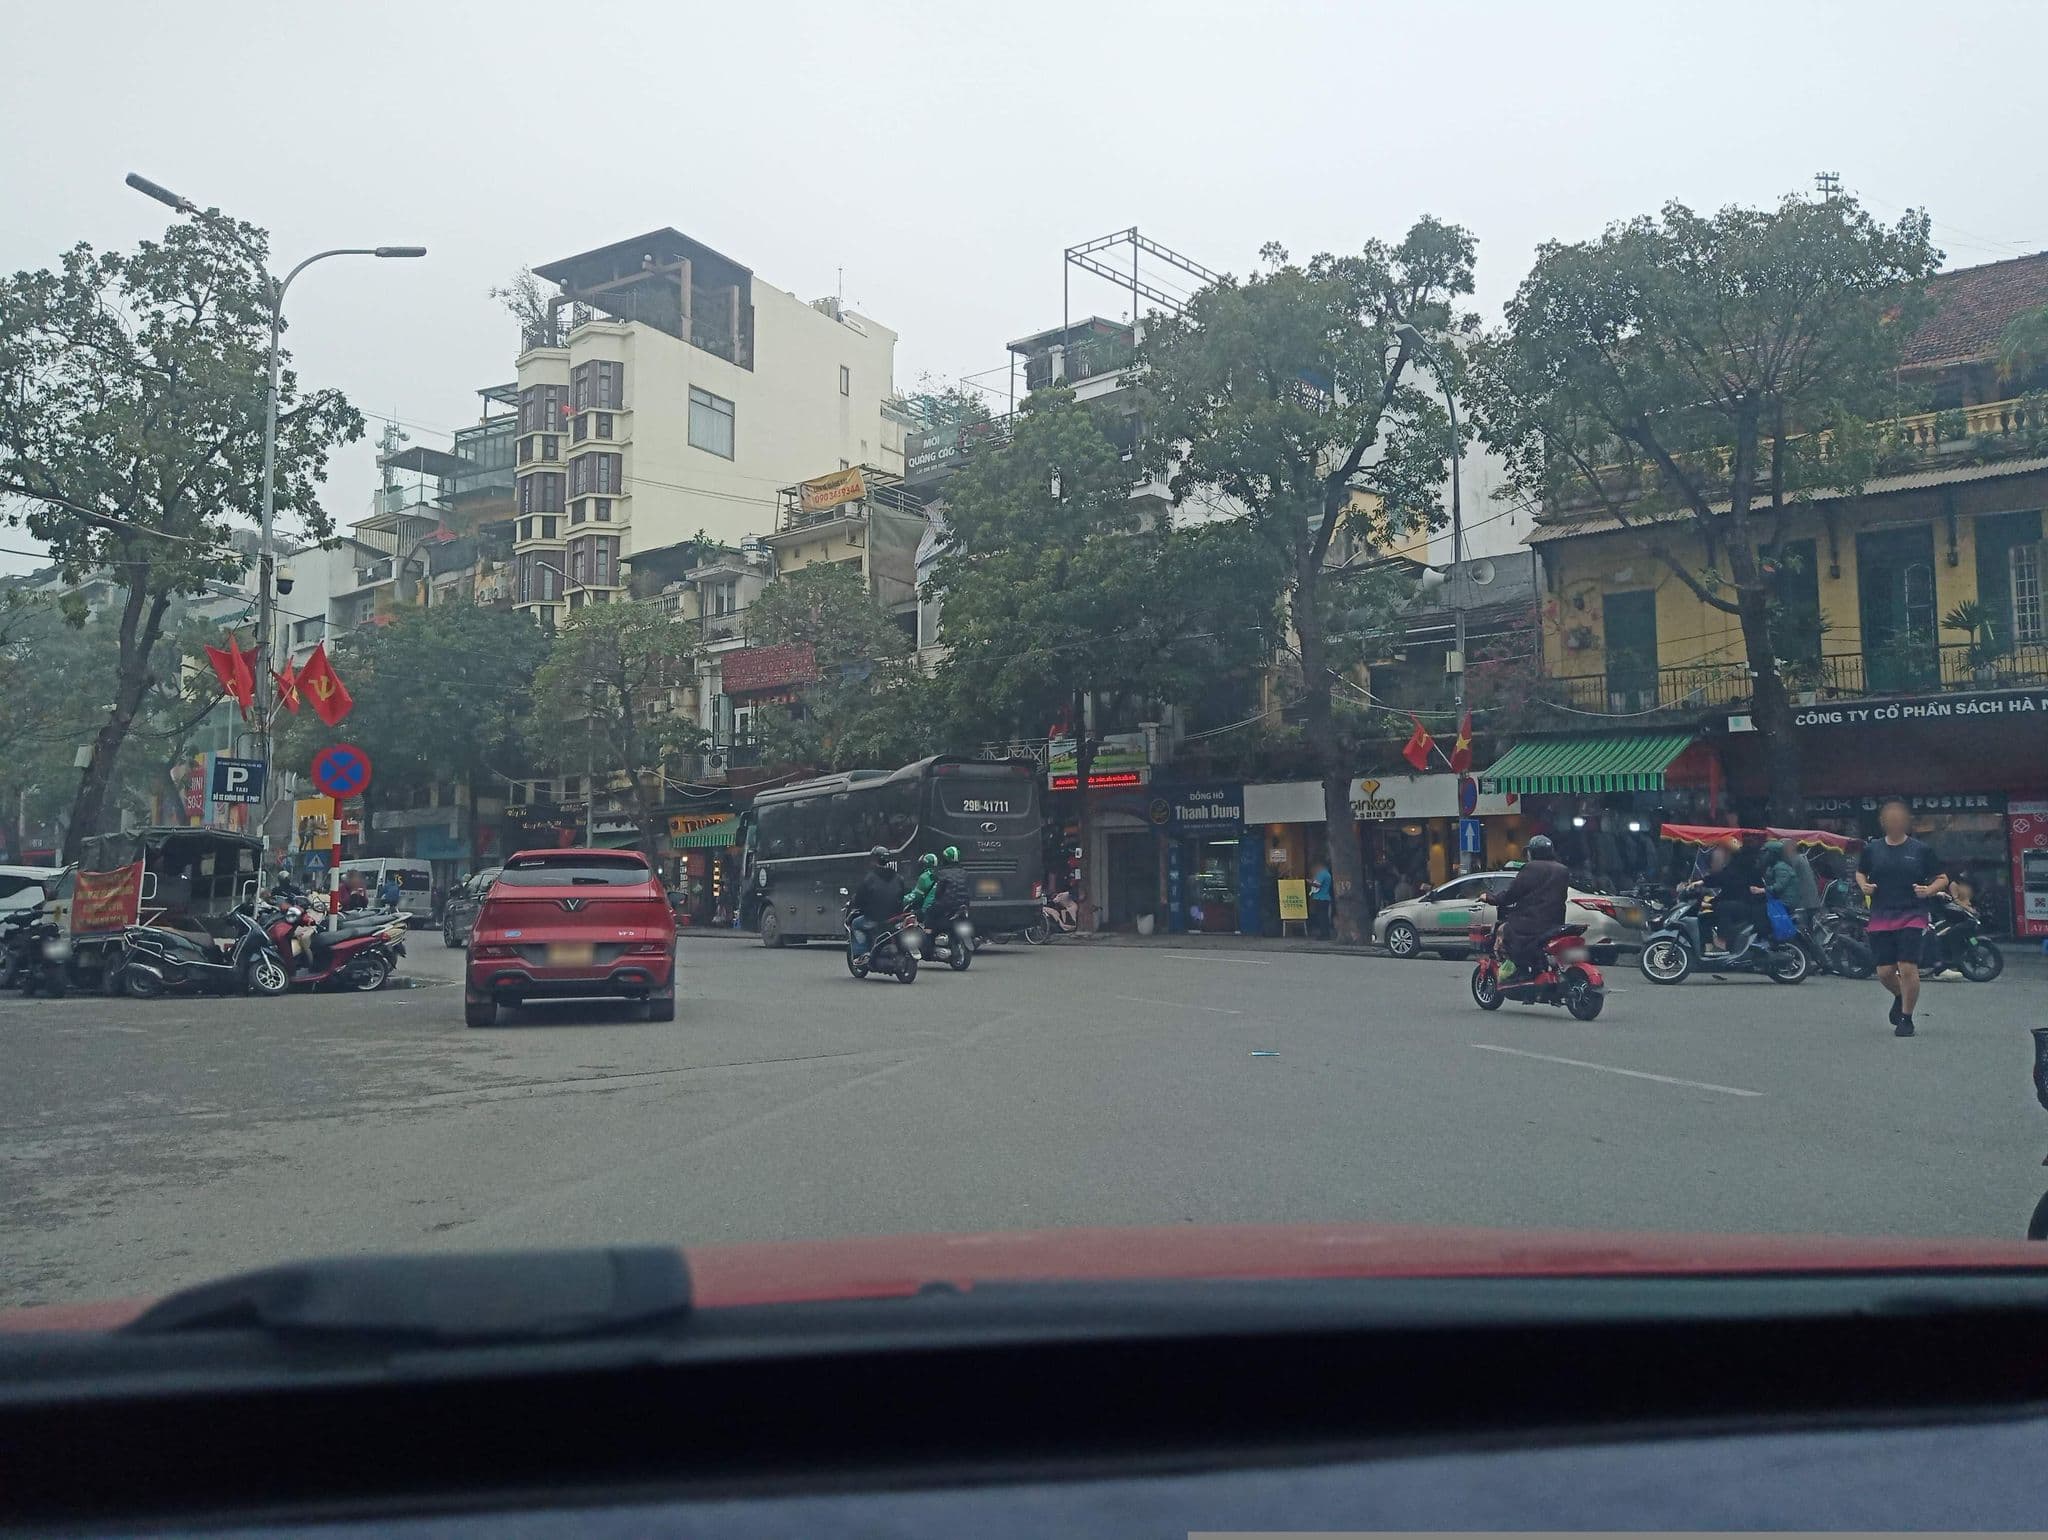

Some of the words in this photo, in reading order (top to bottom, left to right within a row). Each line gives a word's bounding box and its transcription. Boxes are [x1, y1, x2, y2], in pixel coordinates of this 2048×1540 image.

[1795, 711, 1842, 726] CÔNG
[1847, 709, 1869, 722] TY
[1874, 703, 1900, 720] CỔ
[1903, 701, 1951, 718] PHẦN
[1956, 698, 2003, 714] SÁCH
[2008, 696, 2035, 712] HÀ
[226, 767, 249, 792] P
[1175, 804, 1208, 820] Thanh
[1912, 796, 1988, 809] POSTER
